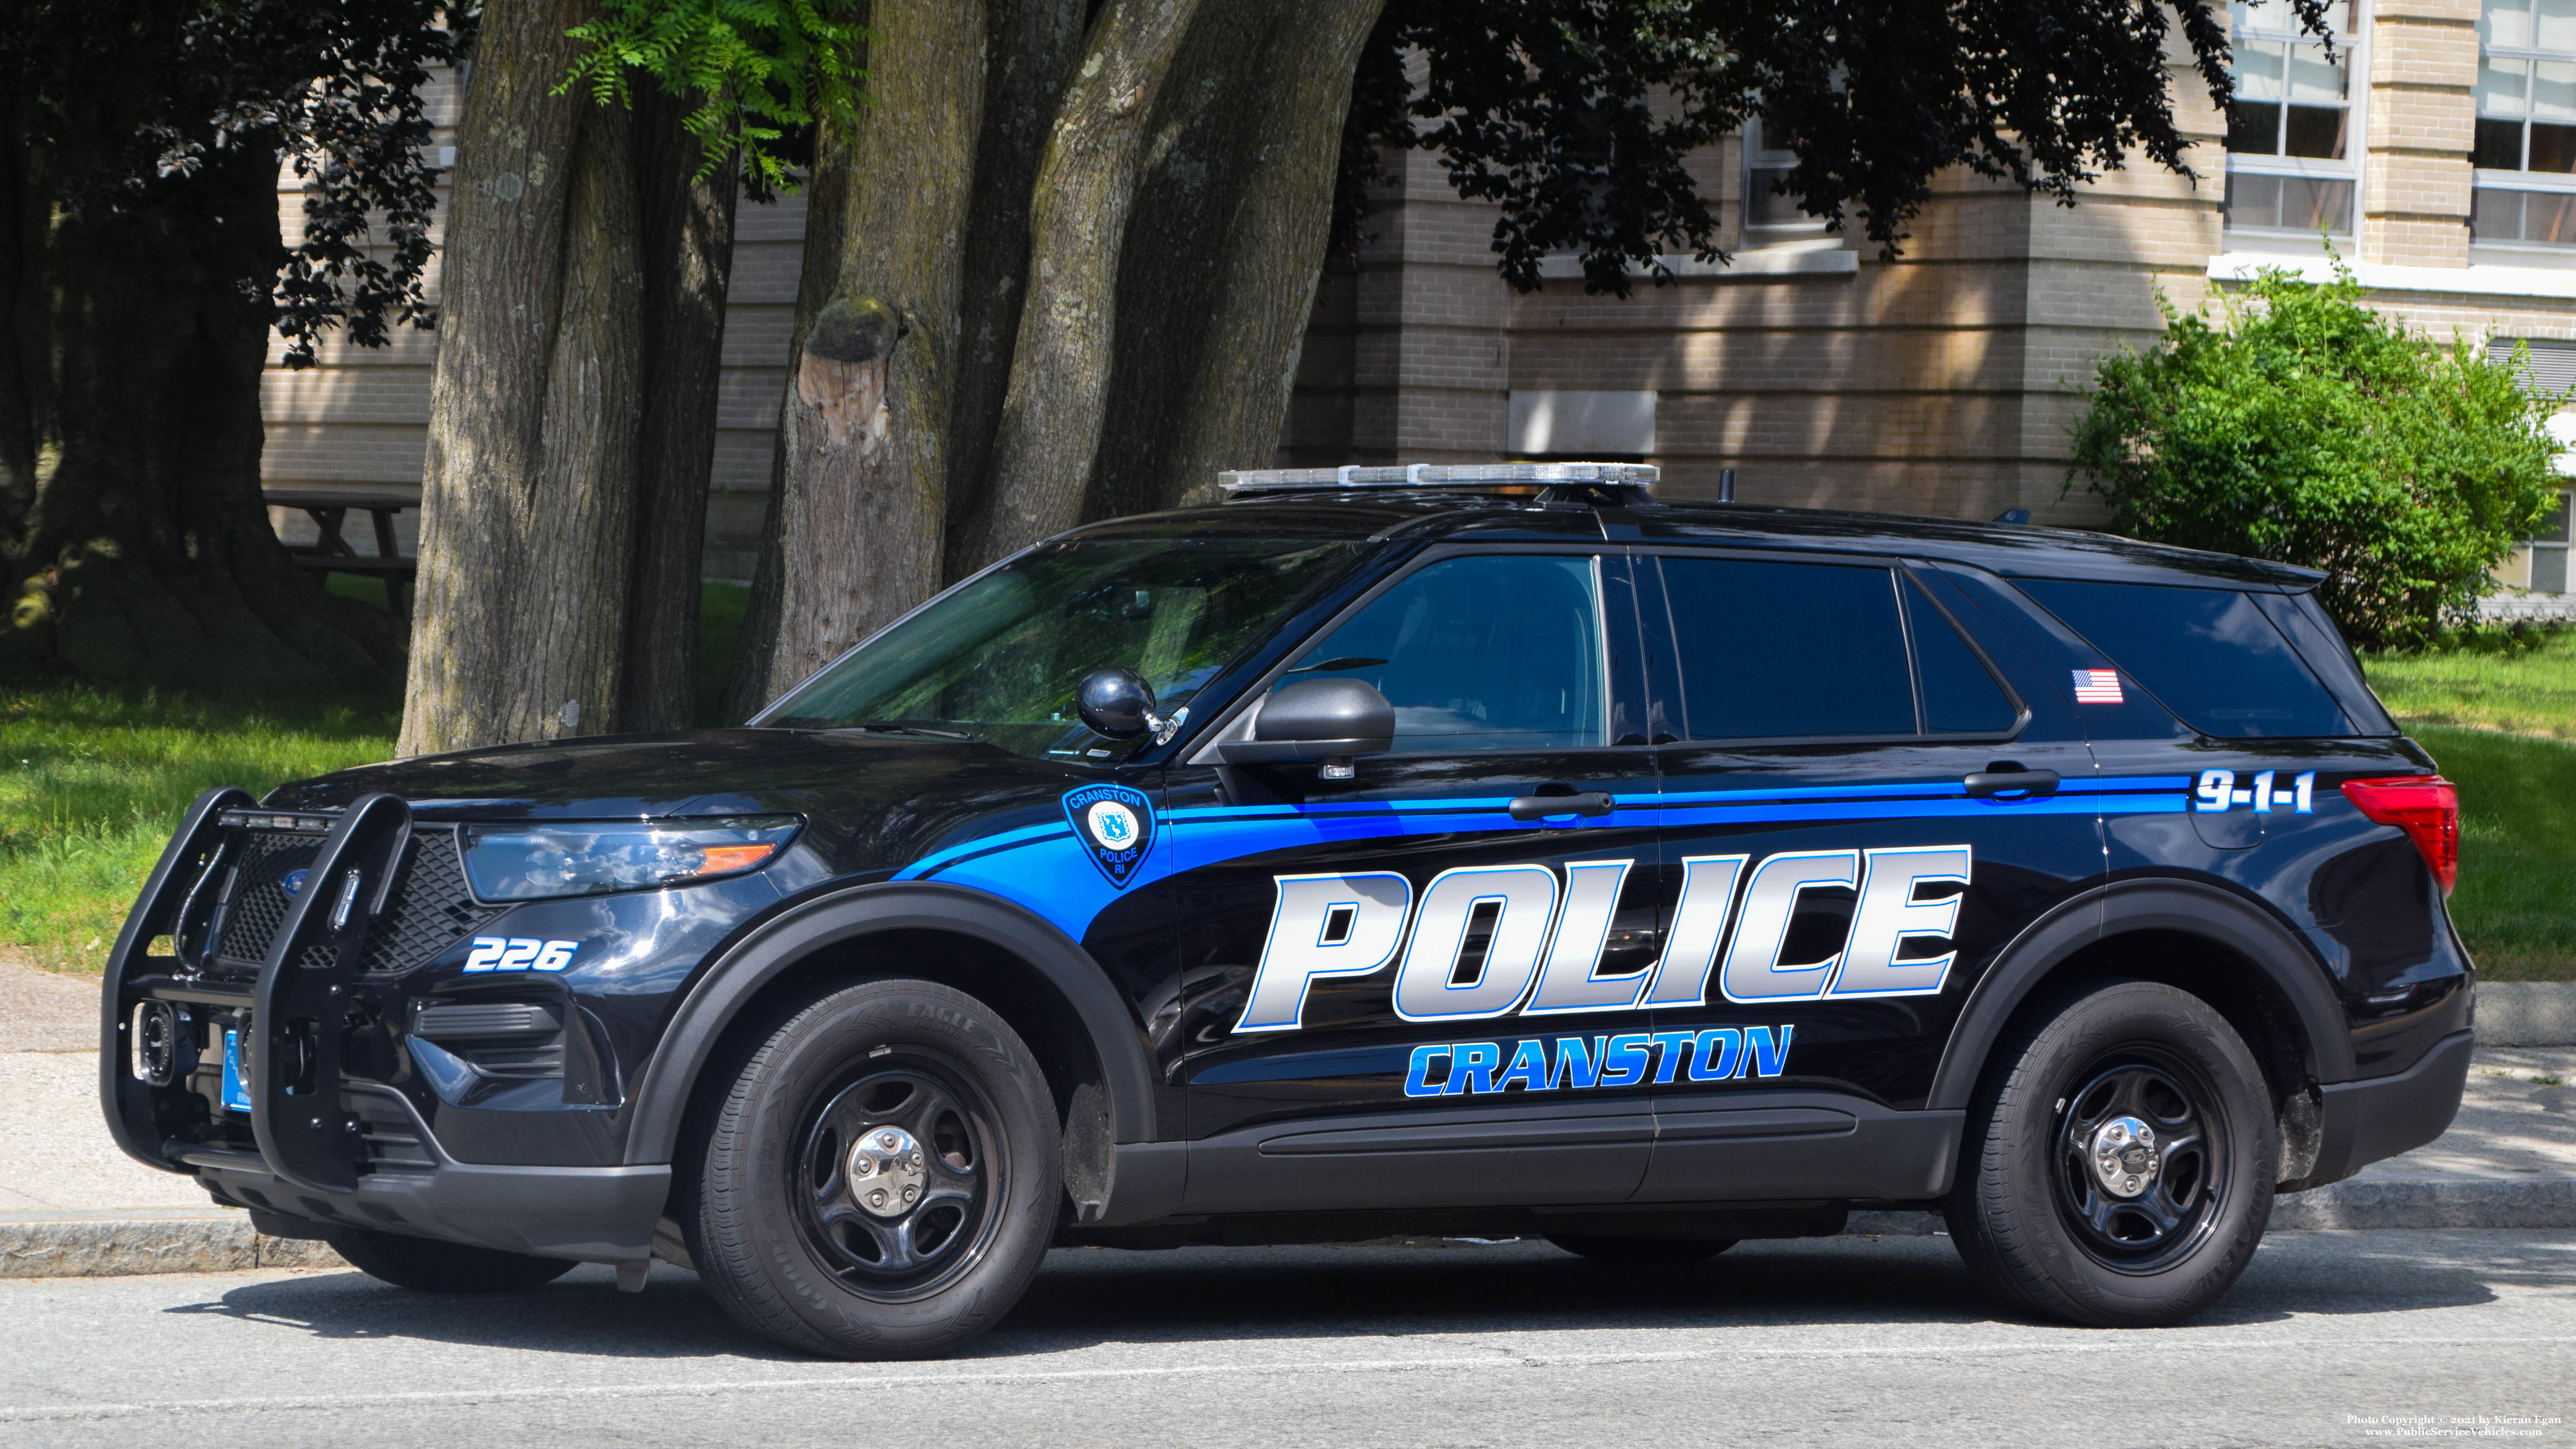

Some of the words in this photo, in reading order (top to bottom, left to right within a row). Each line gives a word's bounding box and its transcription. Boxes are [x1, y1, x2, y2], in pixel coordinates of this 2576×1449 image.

[1069, 789, 1141, 809] CRANSTON
[2195, 768, 2315, 815] 9-1-1
[1100, 846, 1138, 863] POLICE
[1114, 864, 1125, 874] RI
[462, 935, 579, 973] 226
[1230, 844, 1973, 1034] POLICE
[907, 1002, 979, 1035] EAGLE
[1404, 1023, 1795, 1098] CRANSTON
